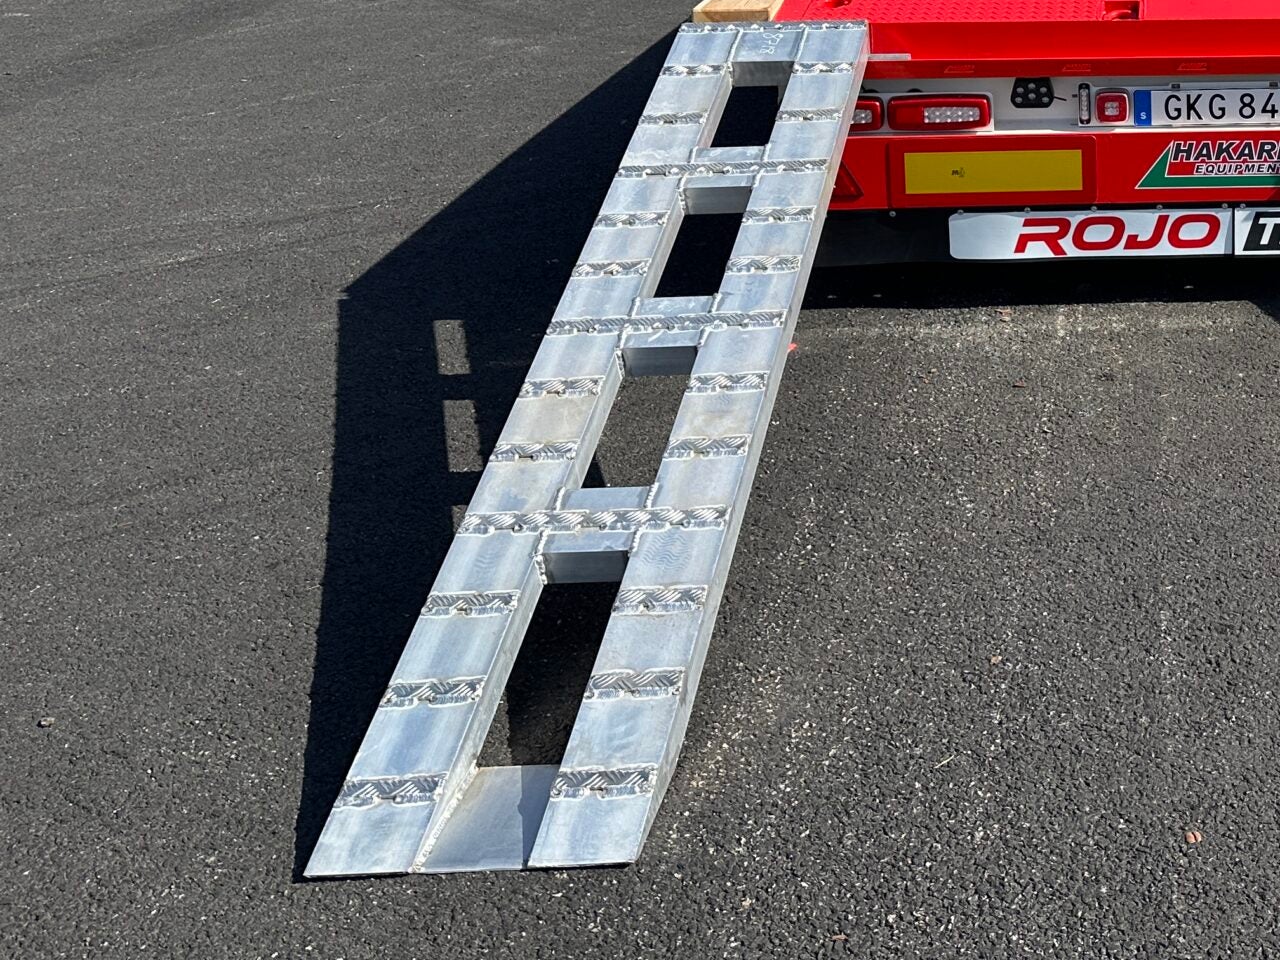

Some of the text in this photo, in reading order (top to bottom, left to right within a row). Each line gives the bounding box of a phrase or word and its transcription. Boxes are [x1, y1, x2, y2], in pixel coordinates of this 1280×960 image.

[1140, 111, 1147, 120] S
[1164, 93, 1226, 121] GKG
[1014, 213, 1221, 256] ROJO
